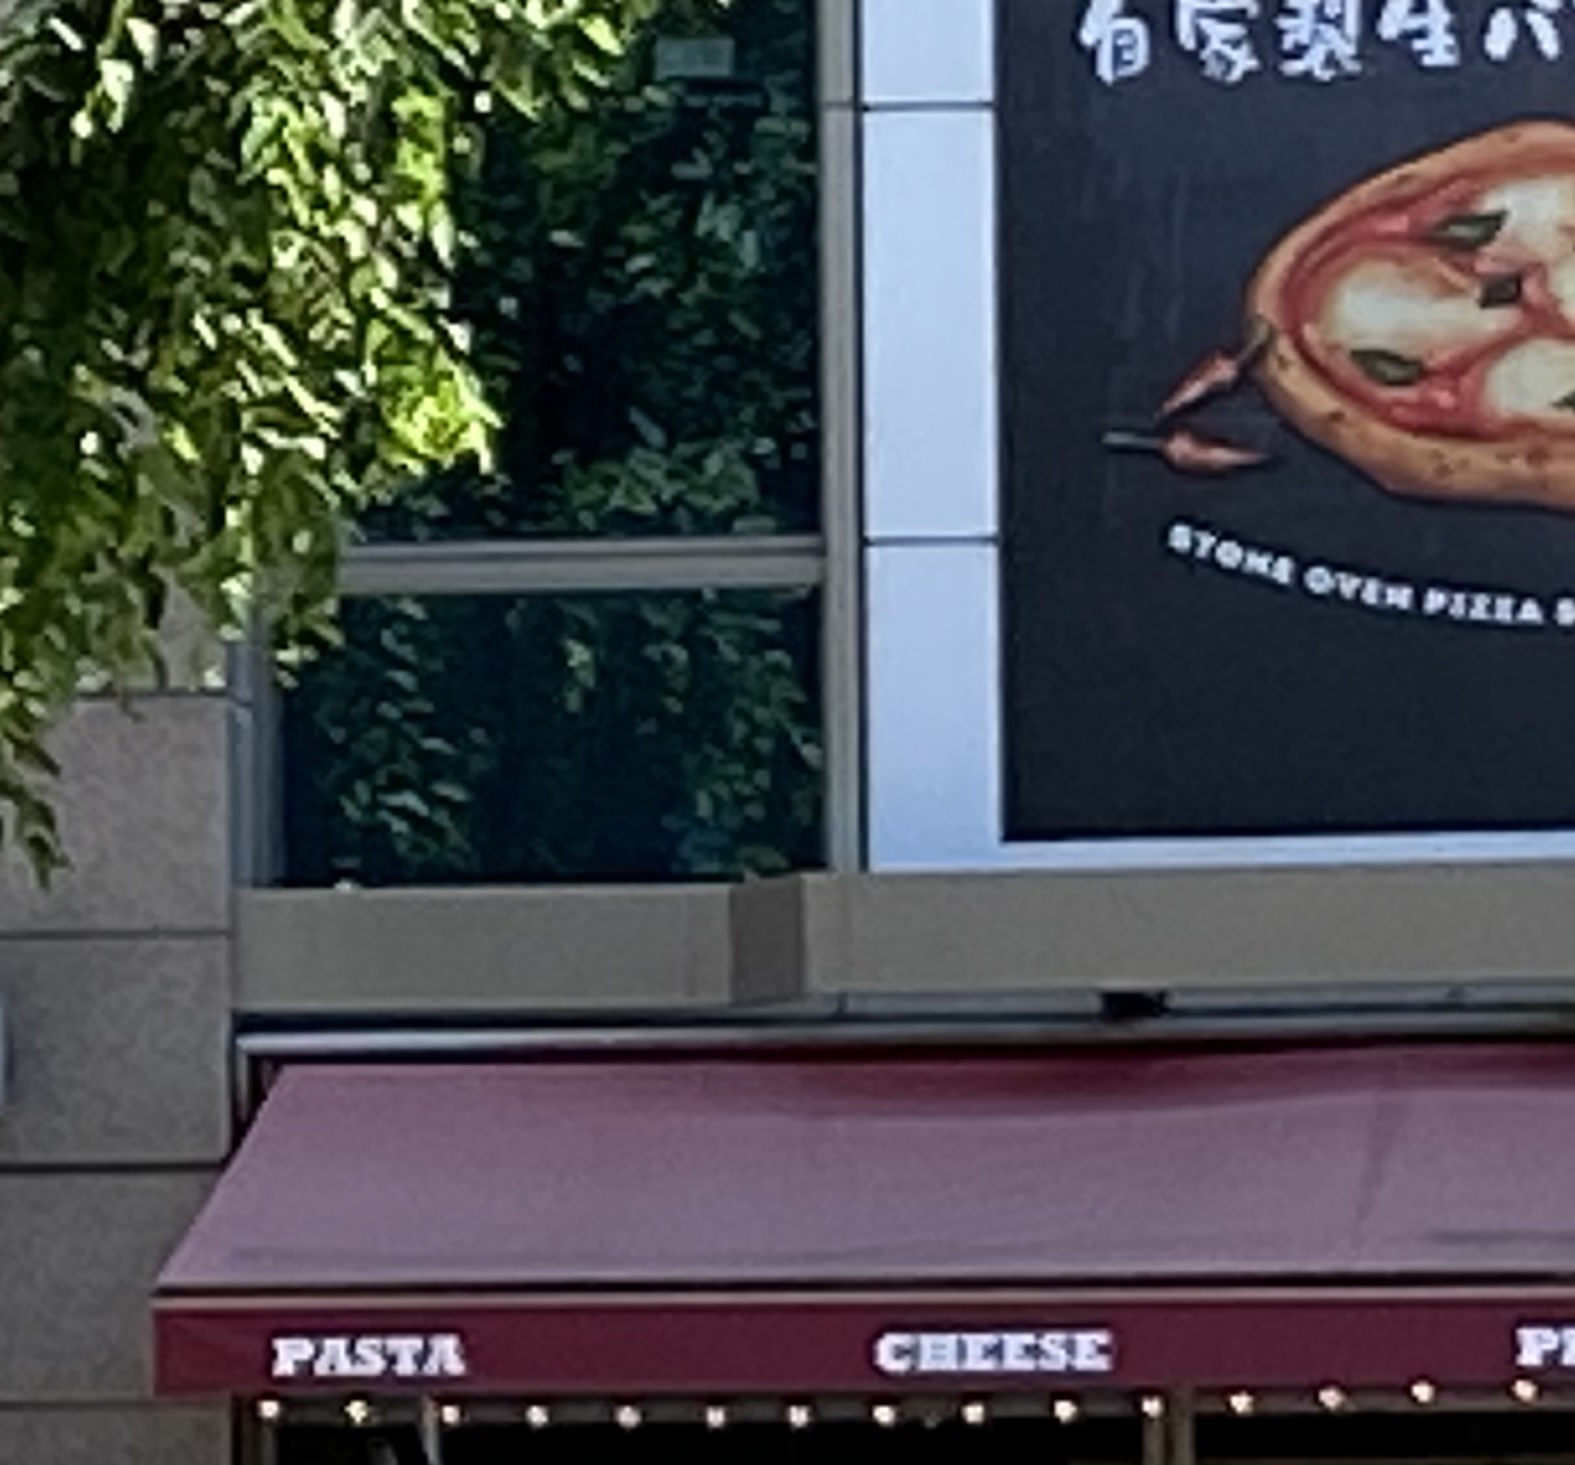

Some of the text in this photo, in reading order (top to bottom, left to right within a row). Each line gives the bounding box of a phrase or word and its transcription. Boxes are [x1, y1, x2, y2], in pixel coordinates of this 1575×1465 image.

[1168, 523, 1294, 585] STONE
[1303, 566, 1414, 609] OVEN
[1424, 588, 1544, 626] PIZZA
[272, 1334, 466, 1377] PASTA
[874, 1331, 1111, 1373] CHEESE
